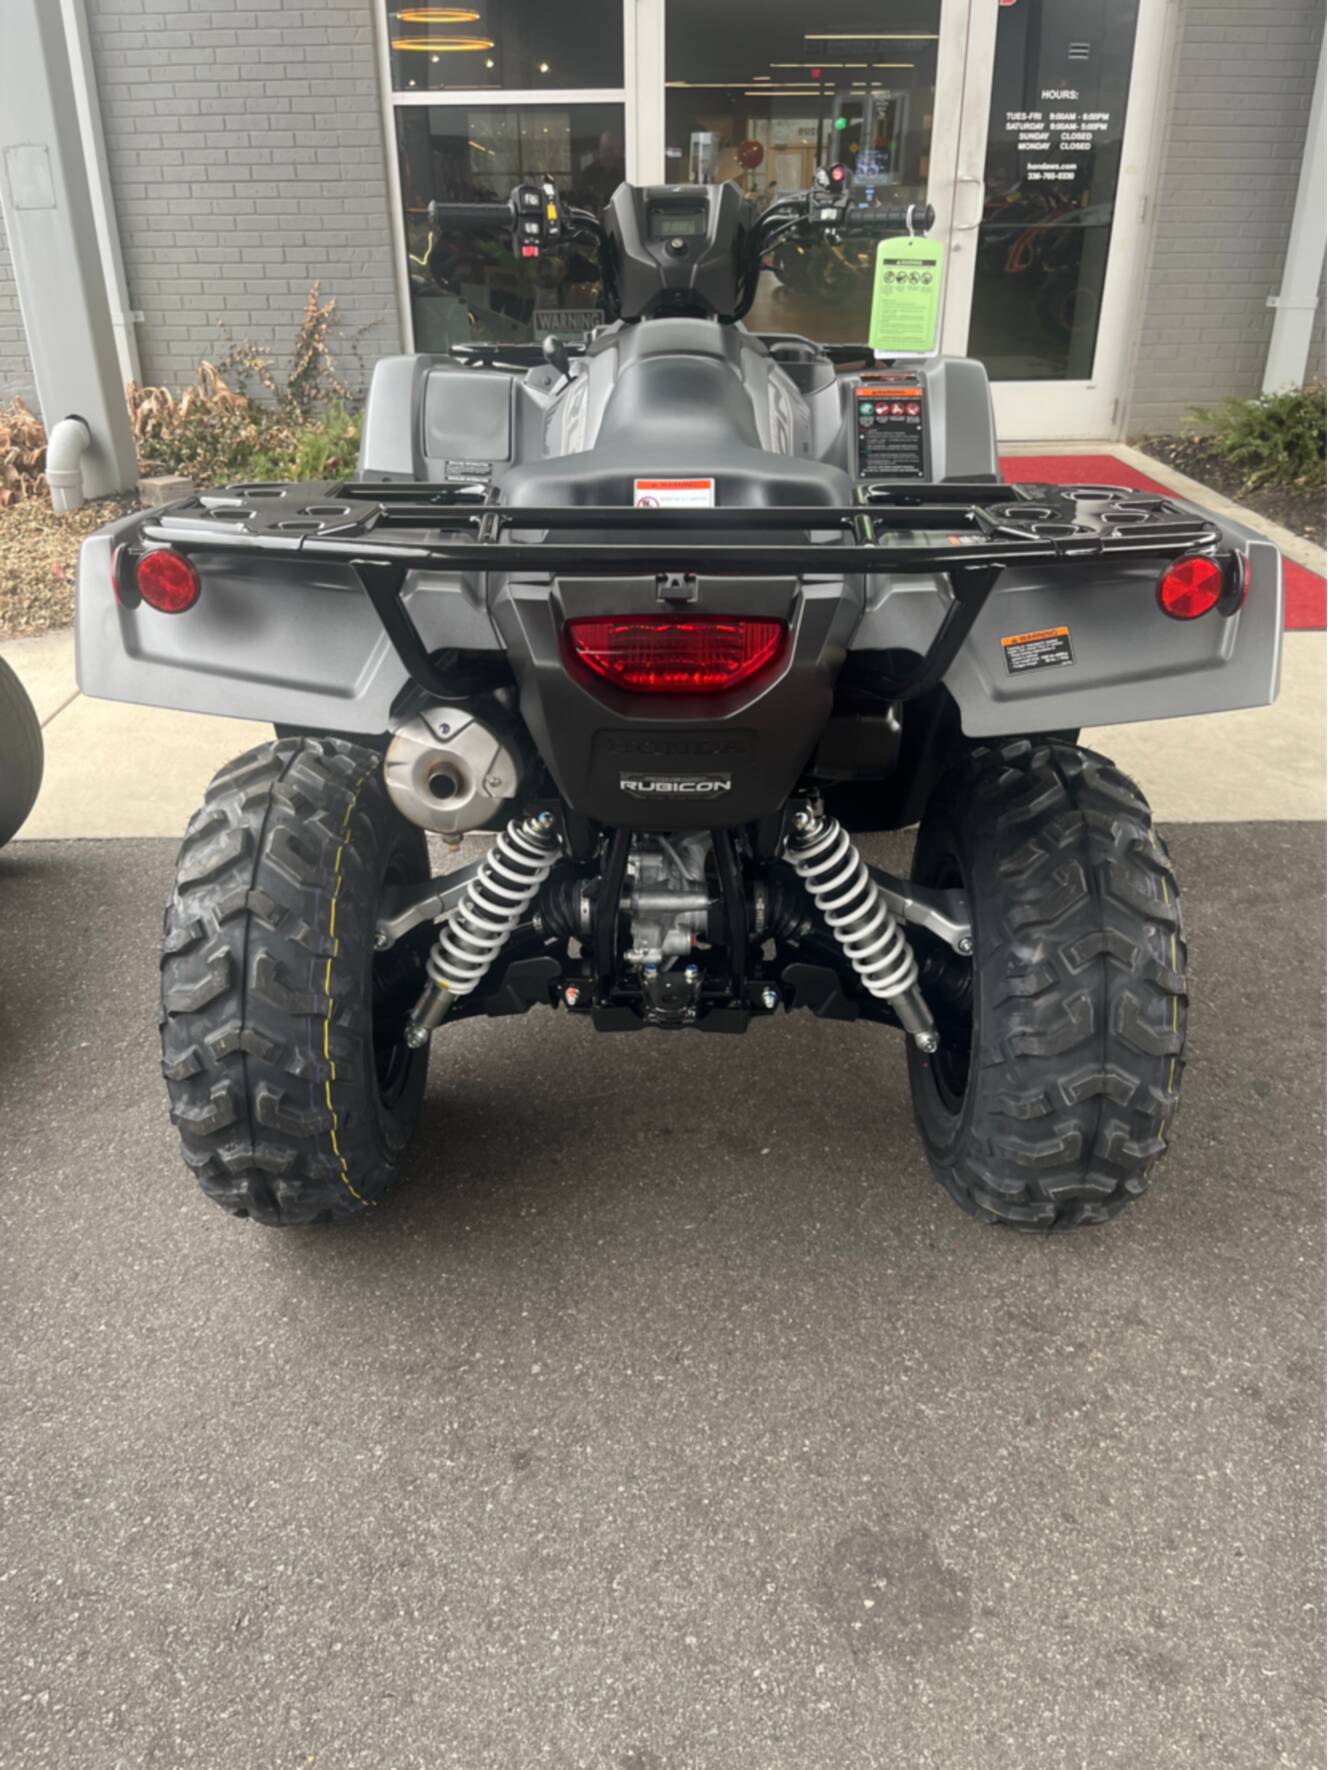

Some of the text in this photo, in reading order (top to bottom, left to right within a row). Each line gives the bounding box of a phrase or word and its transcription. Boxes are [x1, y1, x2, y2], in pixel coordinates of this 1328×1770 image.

[1041, 90, 1079, 100] HOURS:
[1006, 112, 1042, 120] TUES-FRI
[1019, 132, 1092, 140] SUNDAY CLOSED
[1017, 142, 1091, 150] MONDAY CLOSED
[538, 313, 600, 330] WARNING
[619, 780, 732, 792] RUBICON
